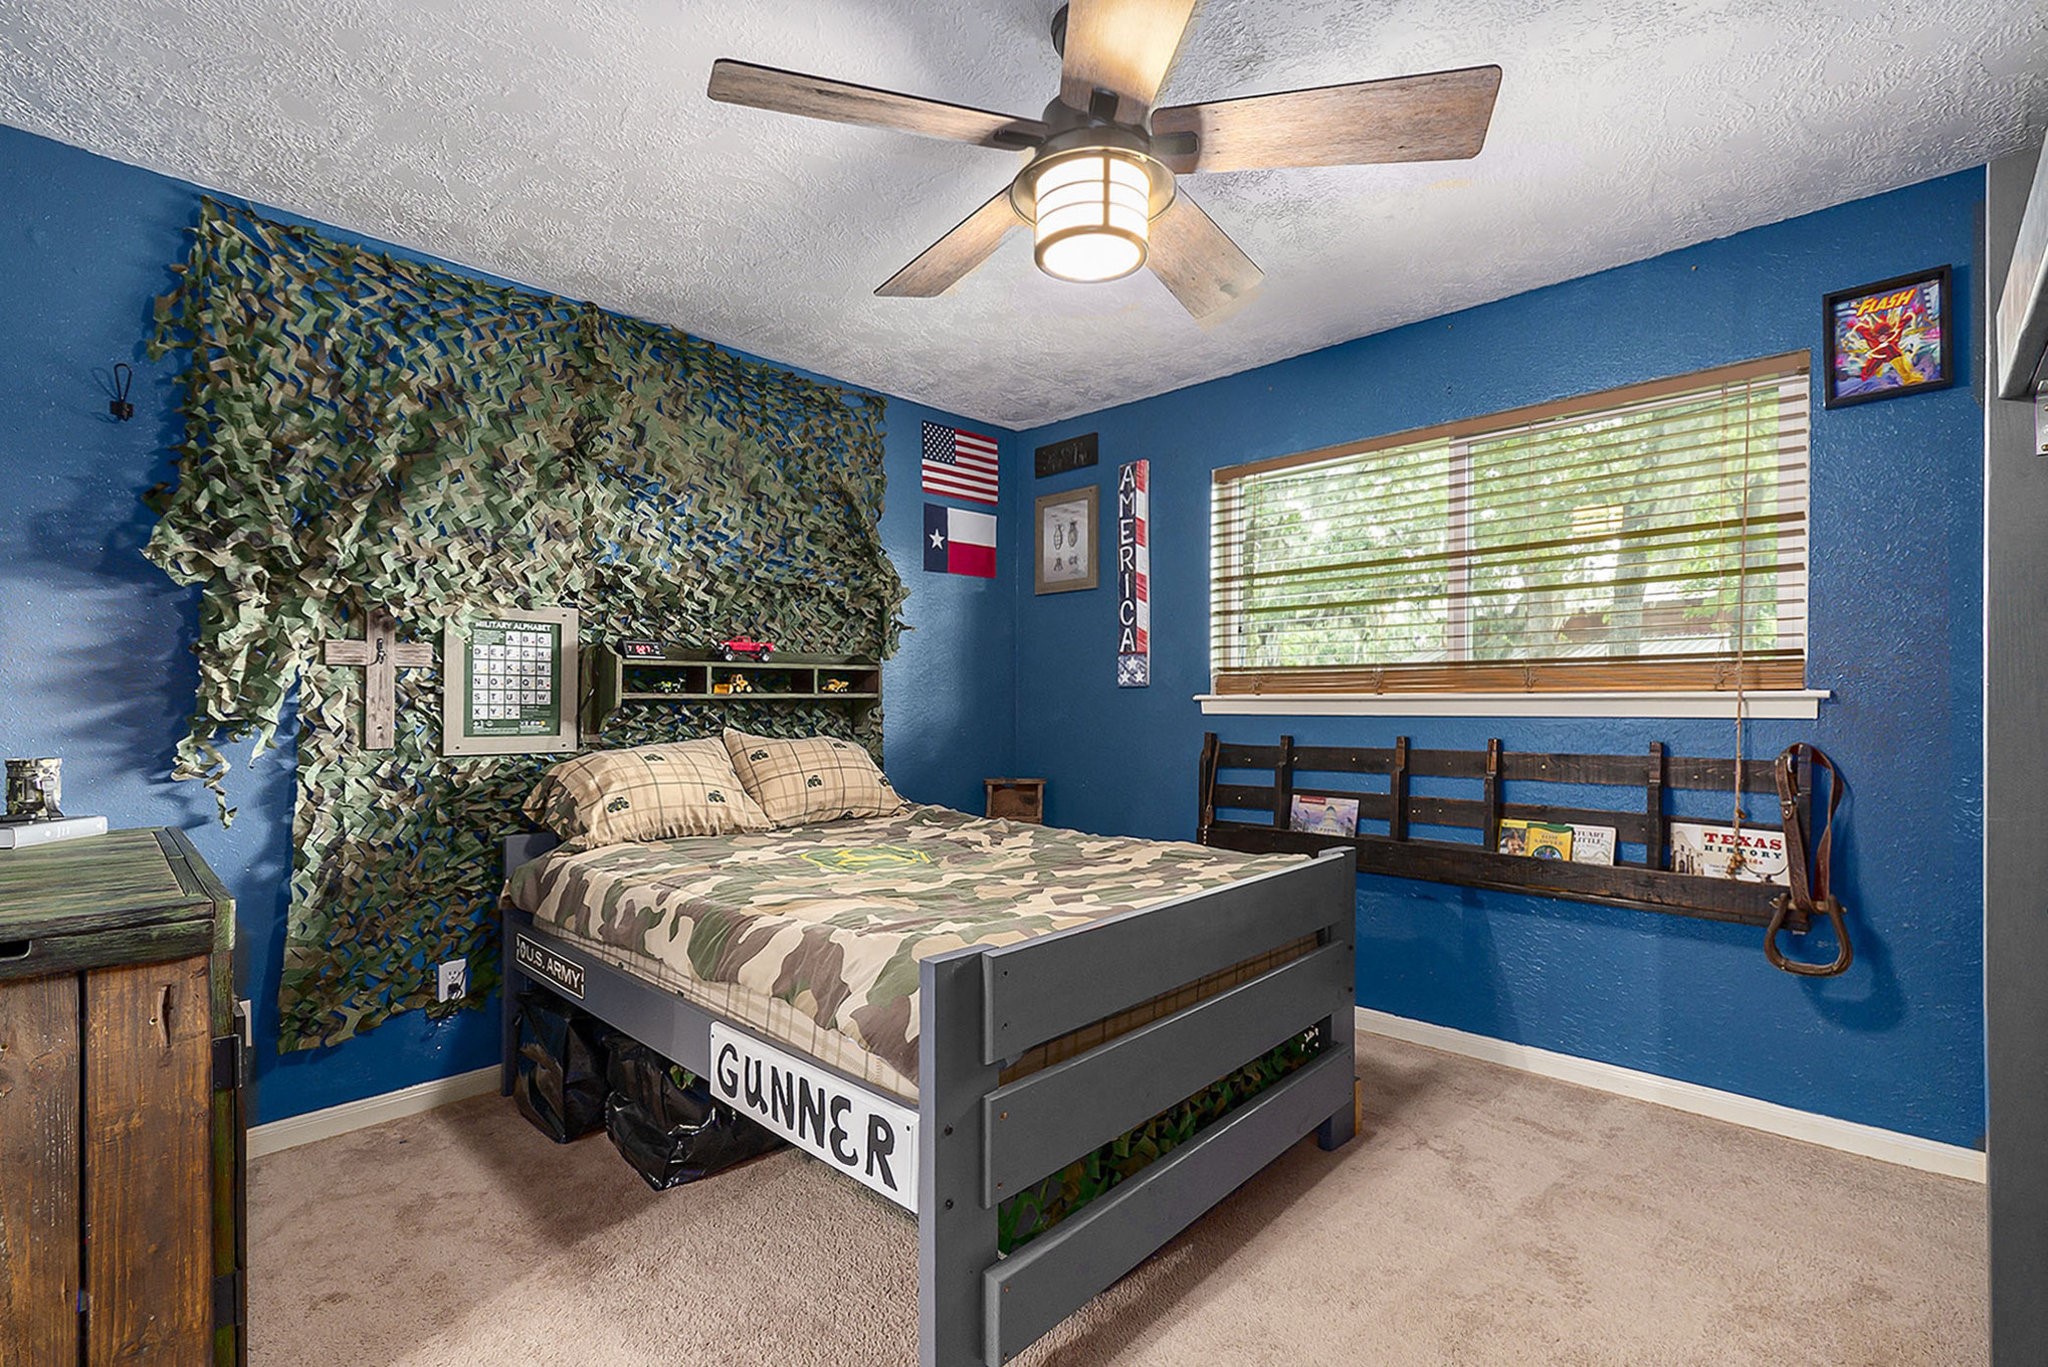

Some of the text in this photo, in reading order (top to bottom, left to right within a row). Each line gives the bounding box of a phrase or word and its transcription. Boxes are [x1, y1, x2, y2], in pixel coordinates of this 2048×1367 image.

[1856, 288, 1918, 317] FLASH
[1119, 464, 1136, 653] AMERICA
[475, 621, 552, 632] MILITARY ALPHABET
[1704, 832, 1782, 851] TEXAS
[1704, 845, 1782, 860] HISTORY
[546, 957, 580, 988] ARMY
[717, 1043, 898, 1192] GUNNER
